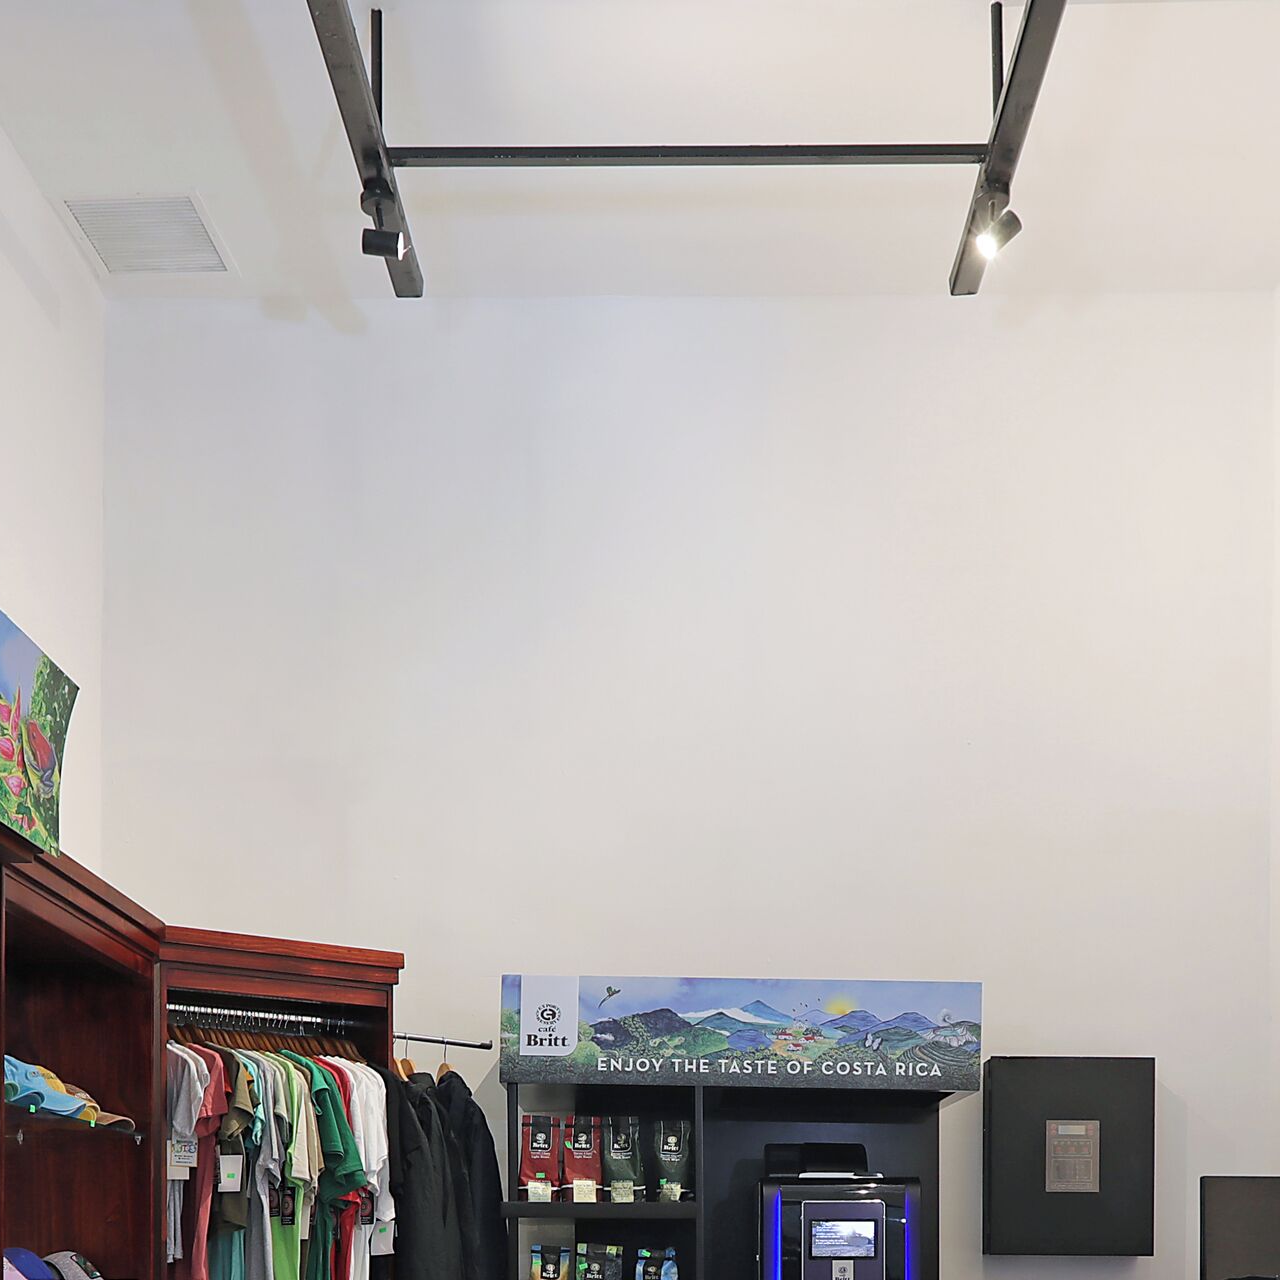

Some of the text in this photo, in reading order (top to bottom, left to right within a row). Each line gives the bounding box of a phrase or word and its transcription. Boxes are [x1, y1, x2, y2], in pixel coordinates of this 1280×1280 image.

[538, 1025, 557, 1033] café
[526, 1033, 569, 1047] Britt
[597, 1057, 943, 1078] ENJOY THE TASTE OF COSTA RICA
